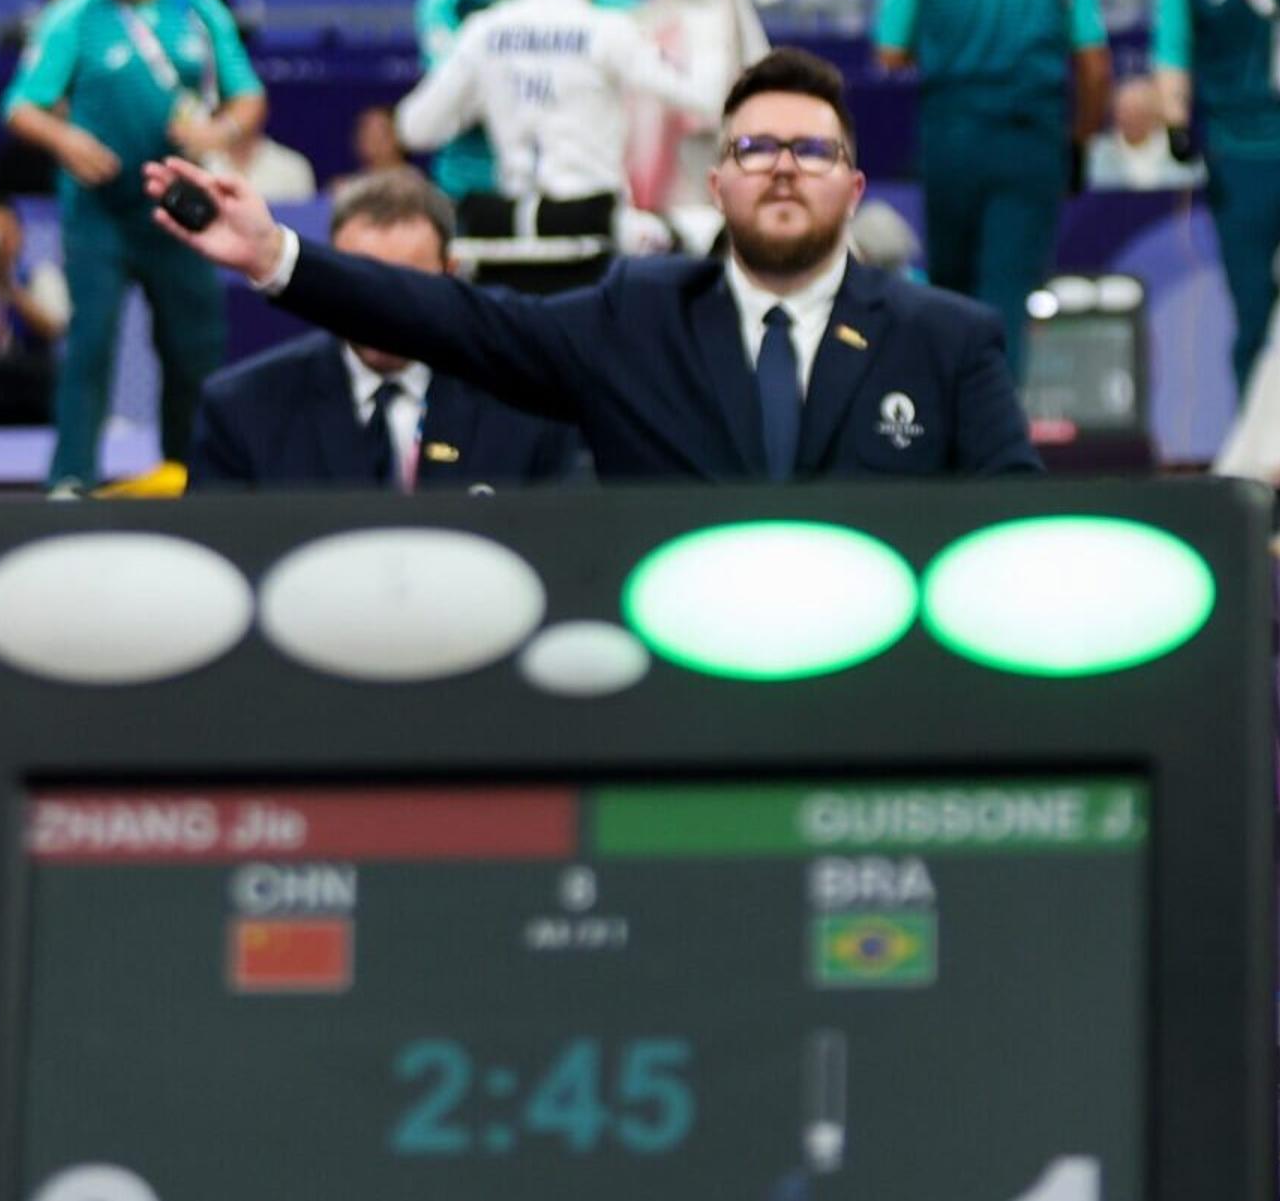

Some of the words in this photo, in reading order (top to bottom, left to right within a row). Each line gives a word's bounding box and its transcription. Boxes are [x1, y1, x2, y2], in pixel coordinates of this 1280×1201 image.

[31, 800, 218, 853] ZHANG
[231, 804, 308, 850] Jie
[802, 790, 1083, 844] GUISSONE
[235, 864, 358, 912] CHN
[810, 856, 936, 908] BRA
[390, 1038, 696, 1154] 2:45
